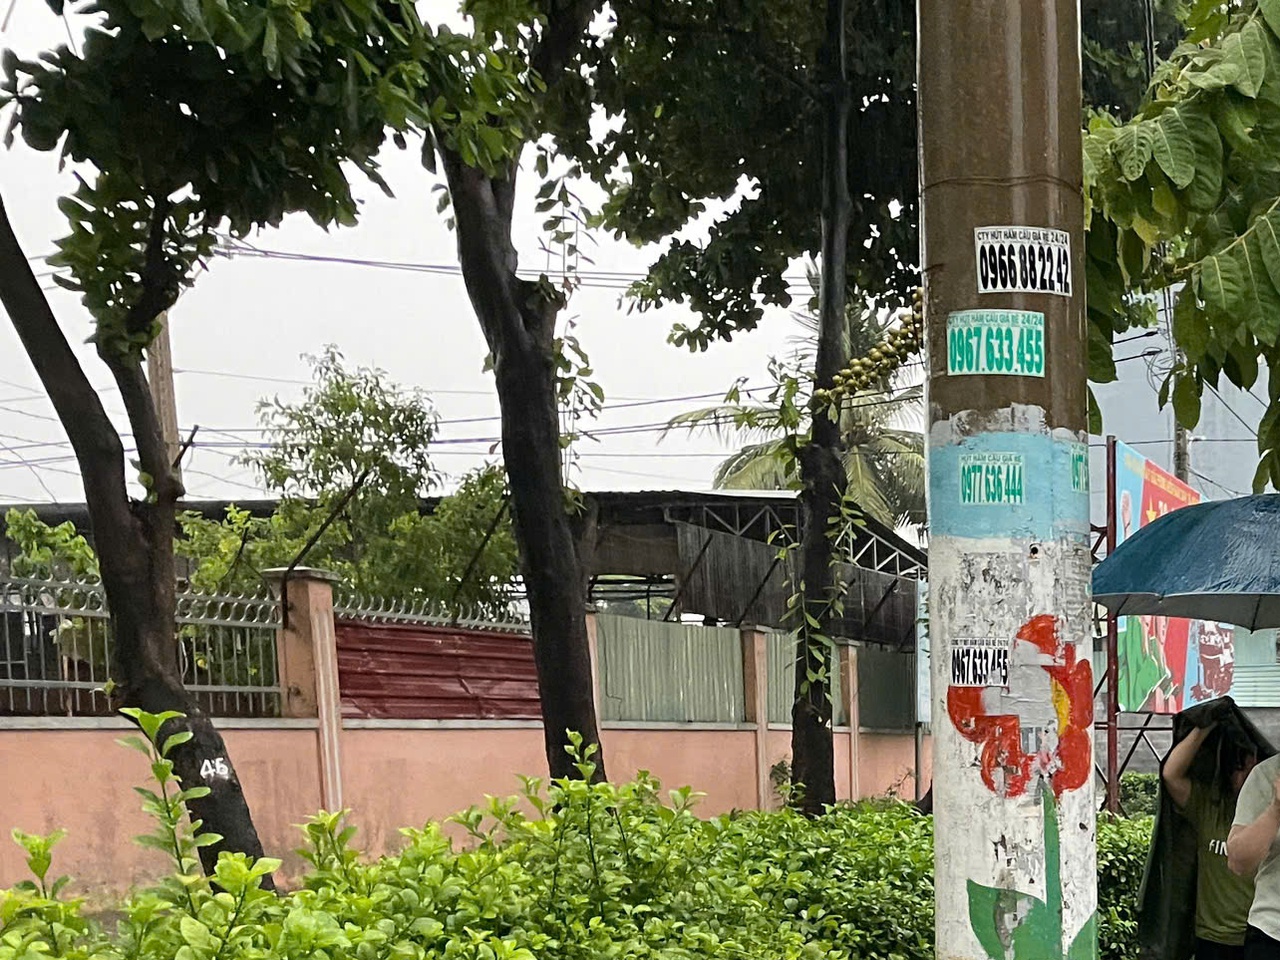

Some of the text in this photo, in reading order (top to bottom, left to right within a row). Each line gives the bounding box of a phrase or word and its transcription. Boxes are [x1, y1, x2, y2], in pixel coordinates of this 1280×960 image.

[980, 244, 1070, 292] 0966.88.22.42
[949, 326, 1043, 373] 0967.633.455
[961, 465, 1023, 503] 0977.636.444
